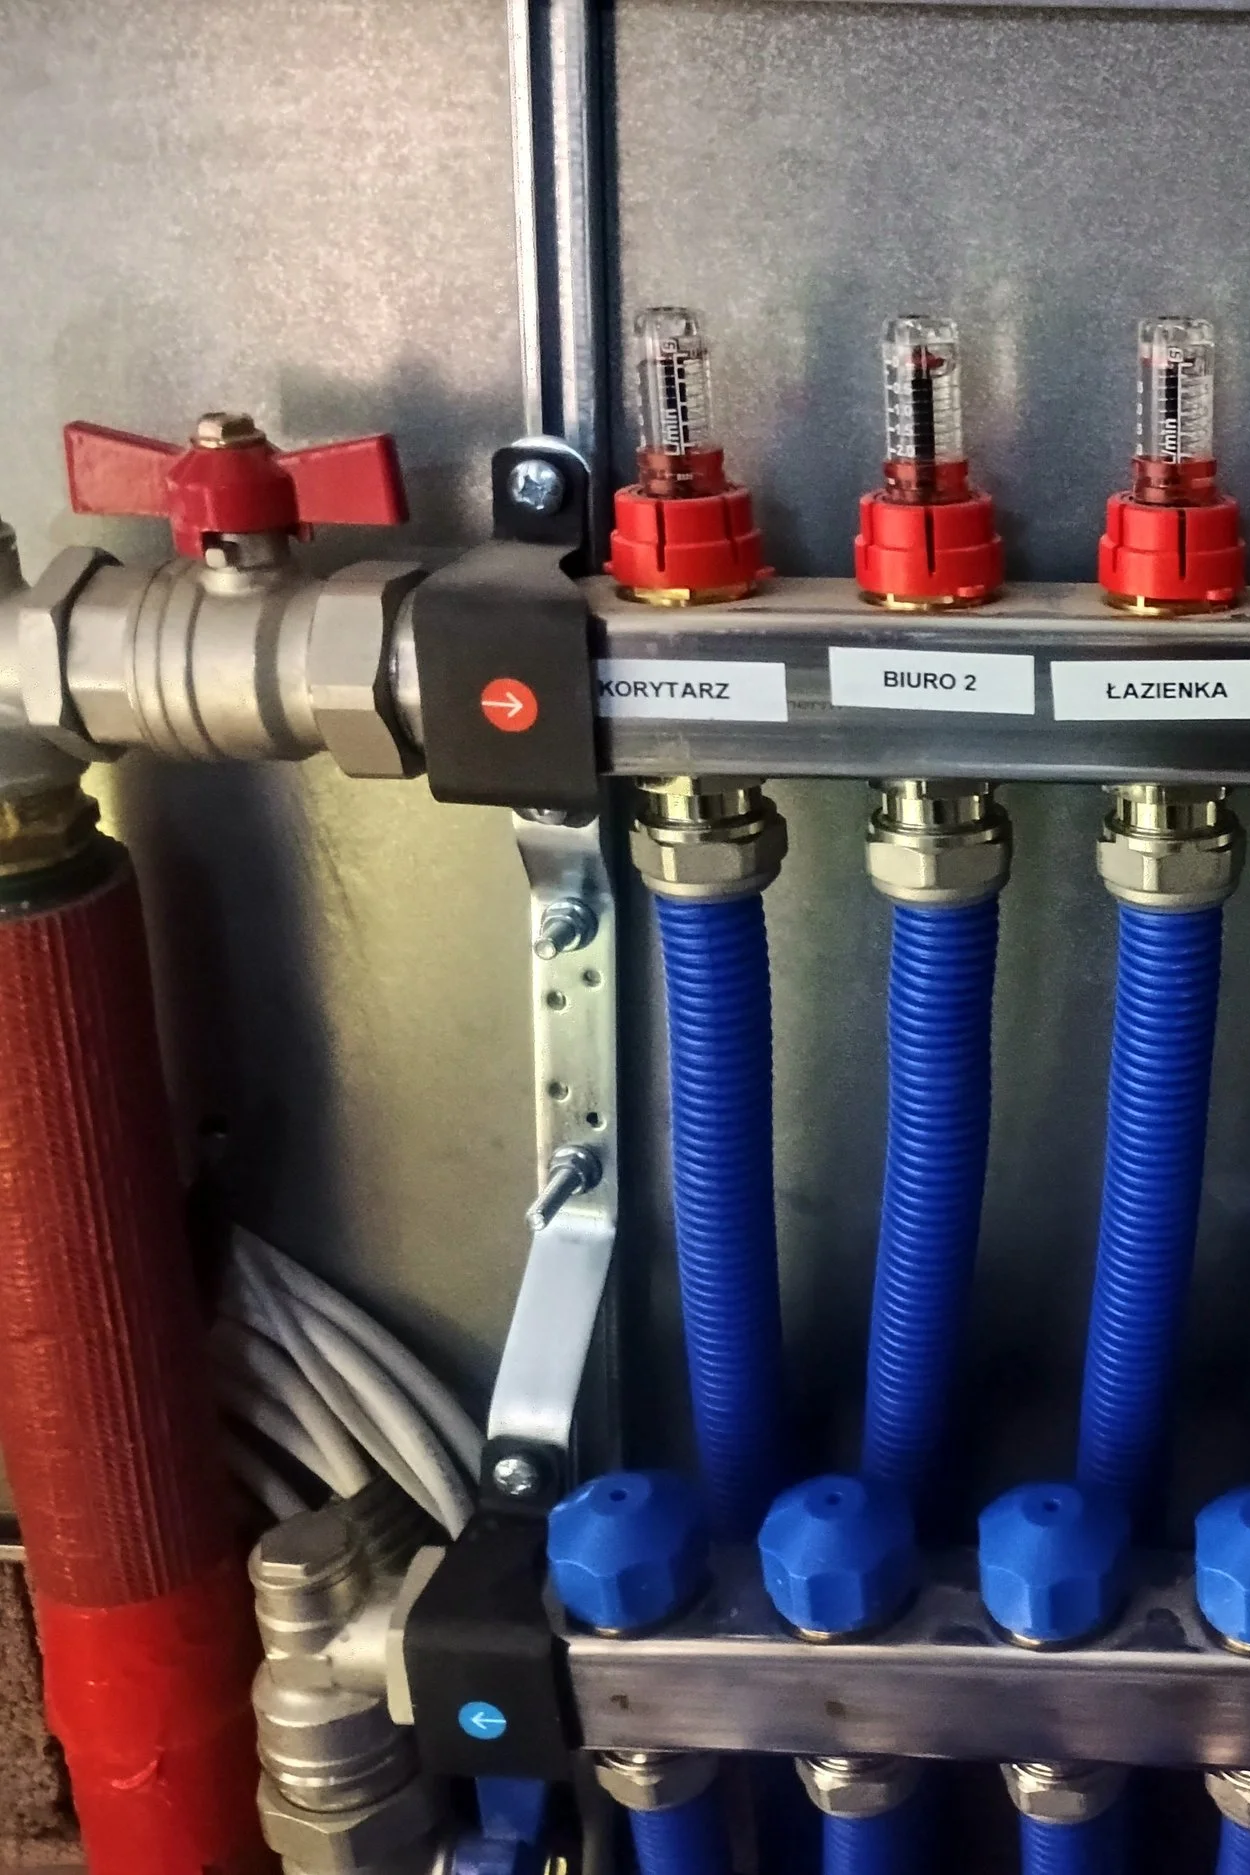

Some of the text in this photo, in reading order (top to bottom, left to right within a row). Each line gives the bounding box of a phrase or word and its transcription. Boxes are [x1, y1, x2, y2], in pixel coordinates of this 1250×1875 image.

[599, 680, 729, 700] KORYTARZ
[883, 670, 977, 691] BIURO 2
[1106, 681, 1228, 699] ŁAZIENKA
